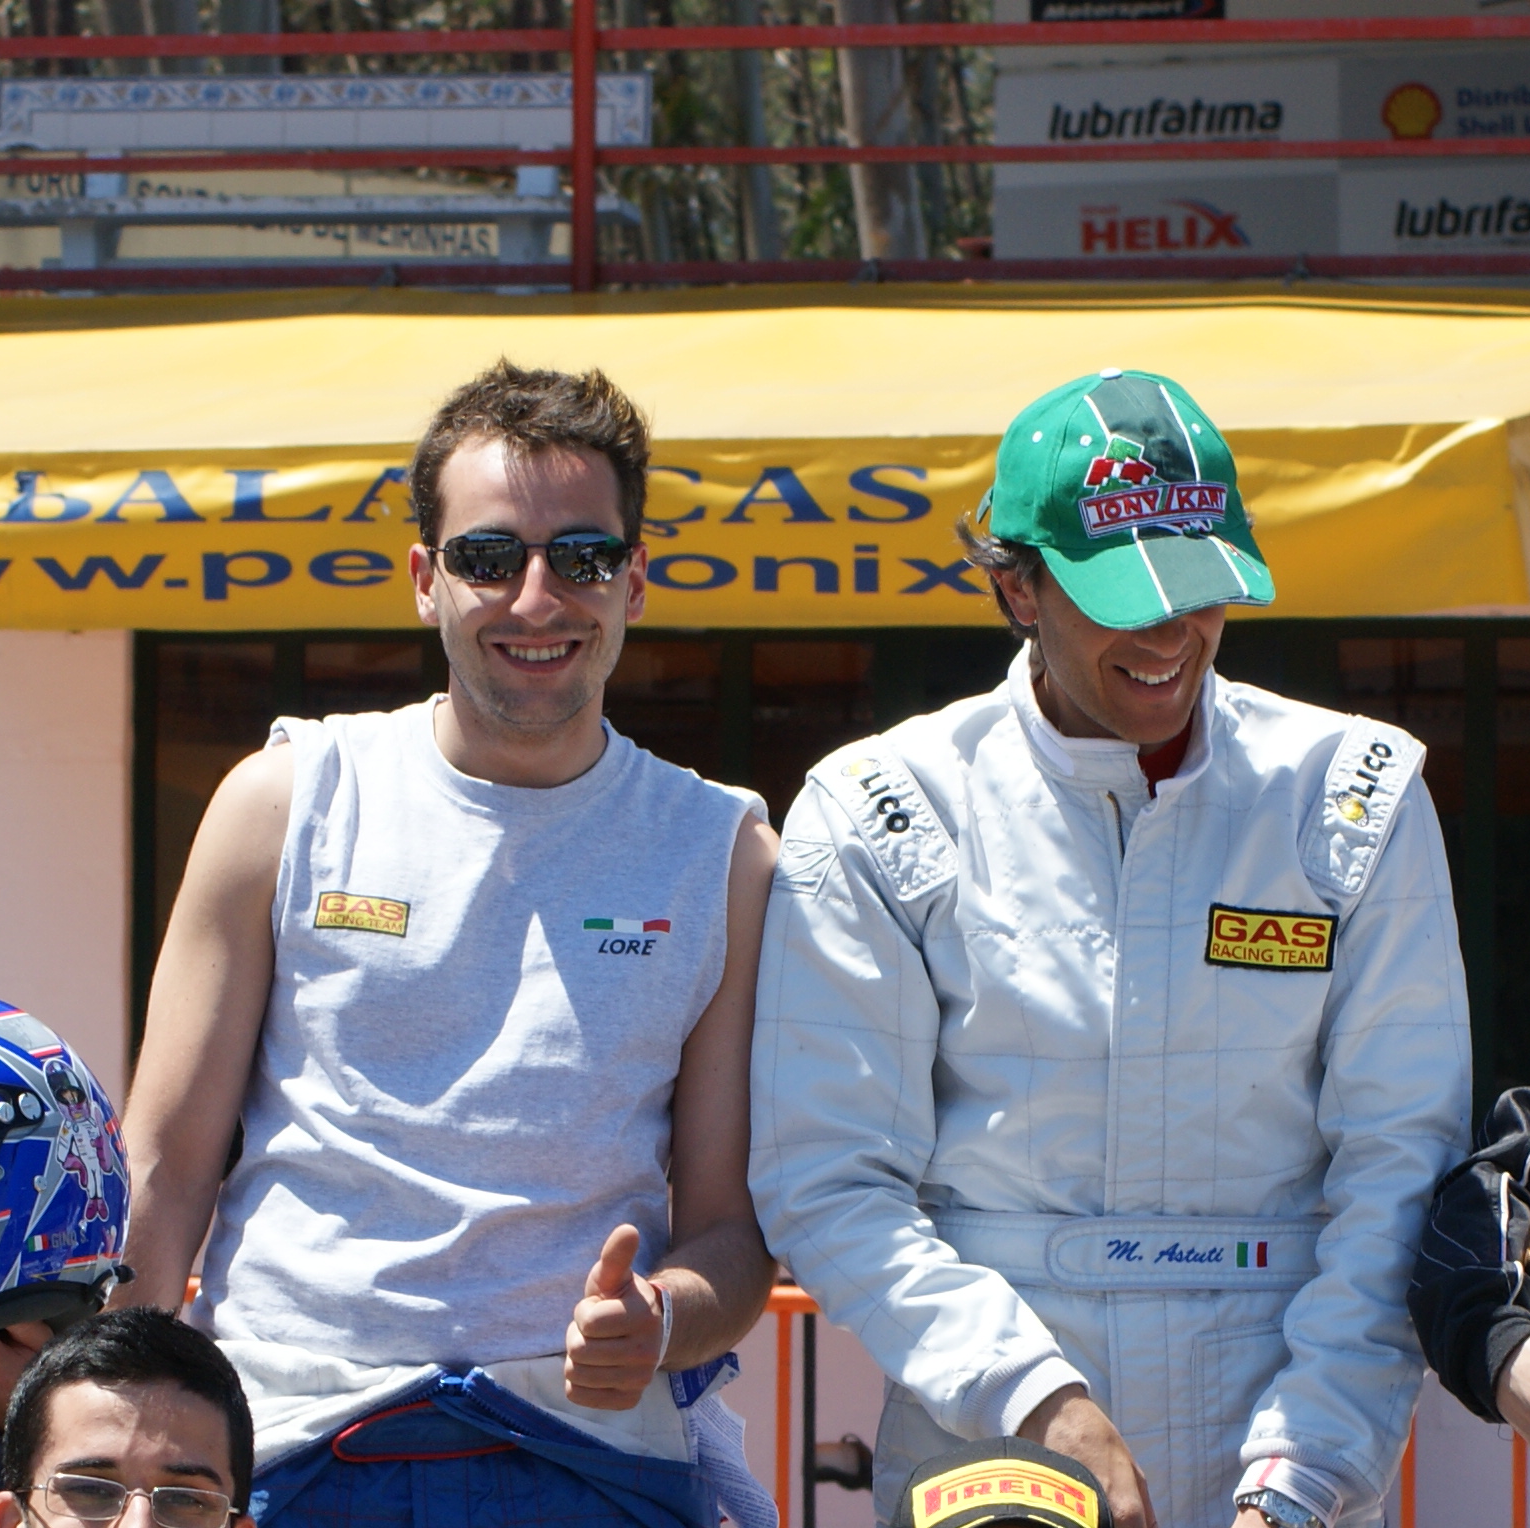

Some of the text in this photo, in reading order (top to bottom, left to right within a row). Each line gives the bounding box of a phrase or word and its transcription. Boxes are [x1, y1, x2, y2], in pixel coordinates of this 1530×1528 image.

[1049, 97, 1284, 142] lubrifatima
[1457, 114, 1514, 136] Shell
[1081, 212, 1244, 253] HELIX
[1086, 489, 1160, 524] TONY
[1349, 740, 1394, 798] LICO
[859, 771, 912, 834] LICO
[317, 912, 405, 933] RACING TEAM
[320, 894, 407, 921] GAS
[598, 938, 657, 956] LORE
[1213, 913, 1328, 947] GAS
[1211, 943, 1327, 968] RACING TEAM
[1106, 1239, 1224, 1265] M. Astuti
[924, 1466, 1088, 1518] PIRELLI
